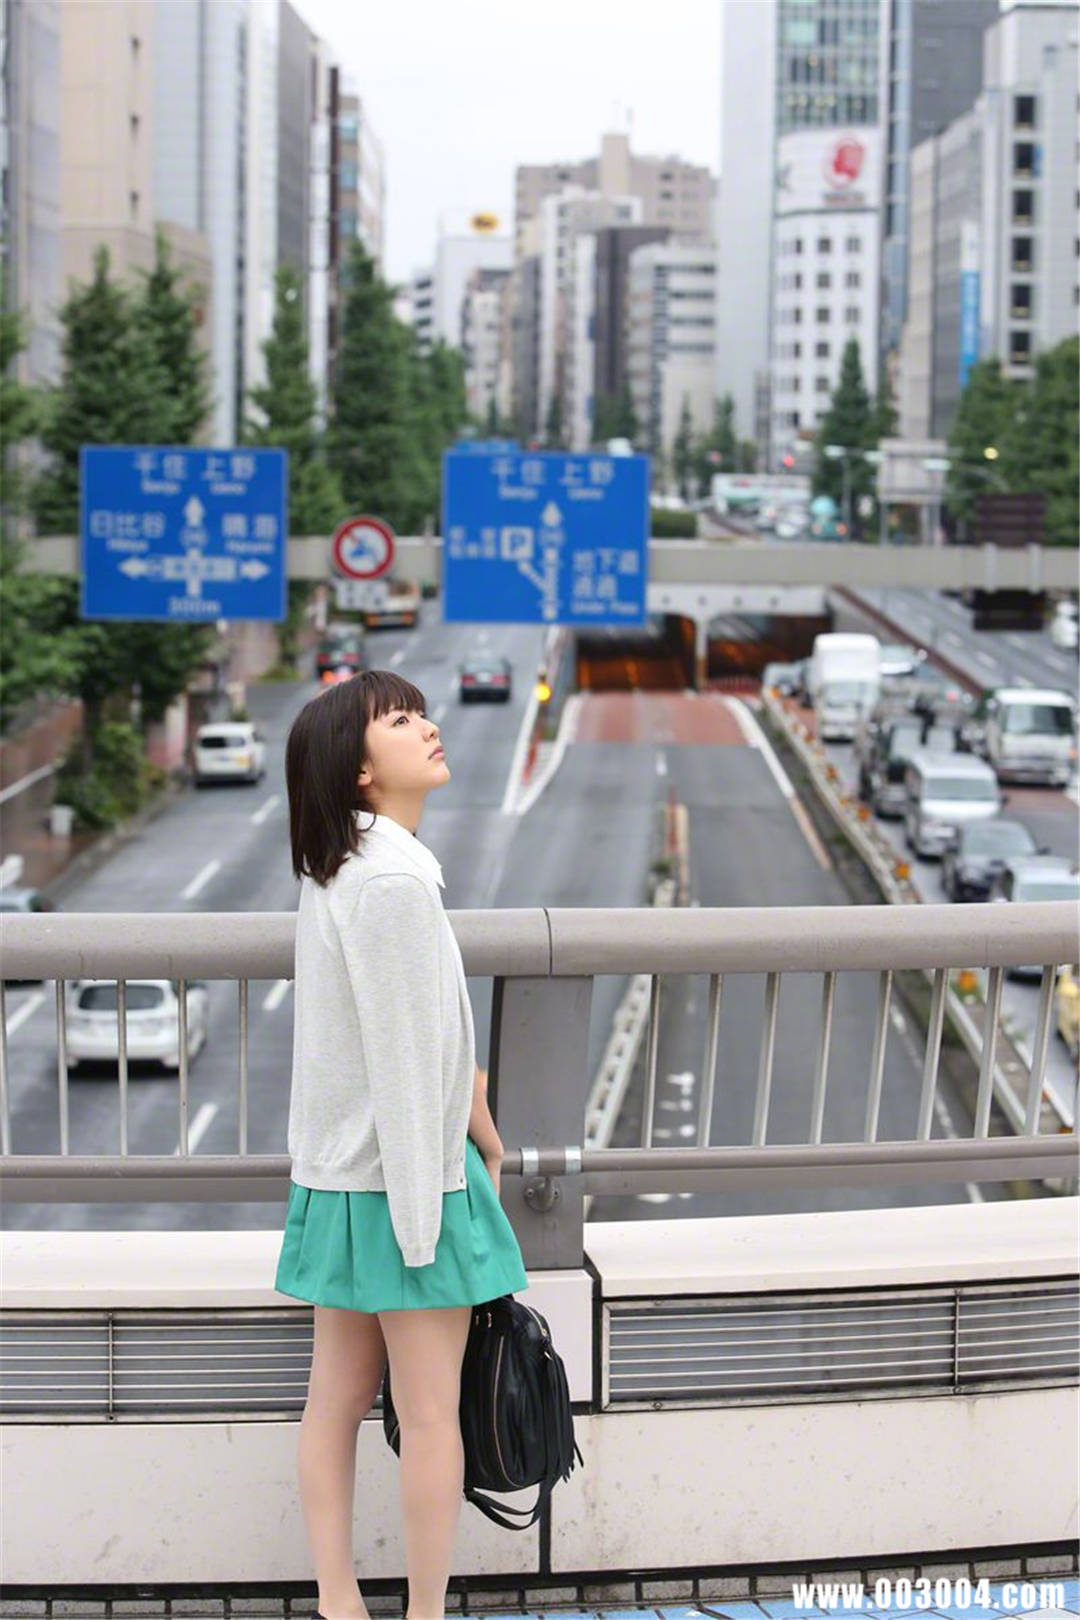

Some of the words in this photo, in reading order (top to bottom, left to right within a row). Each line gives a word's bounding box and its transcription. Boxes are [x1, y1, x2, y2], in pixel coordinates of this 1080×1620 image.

[202, 455, 256, 481] 上野
[559, 460, 614, 486] 上野
[89, 509, 166, 539] 日比谷
